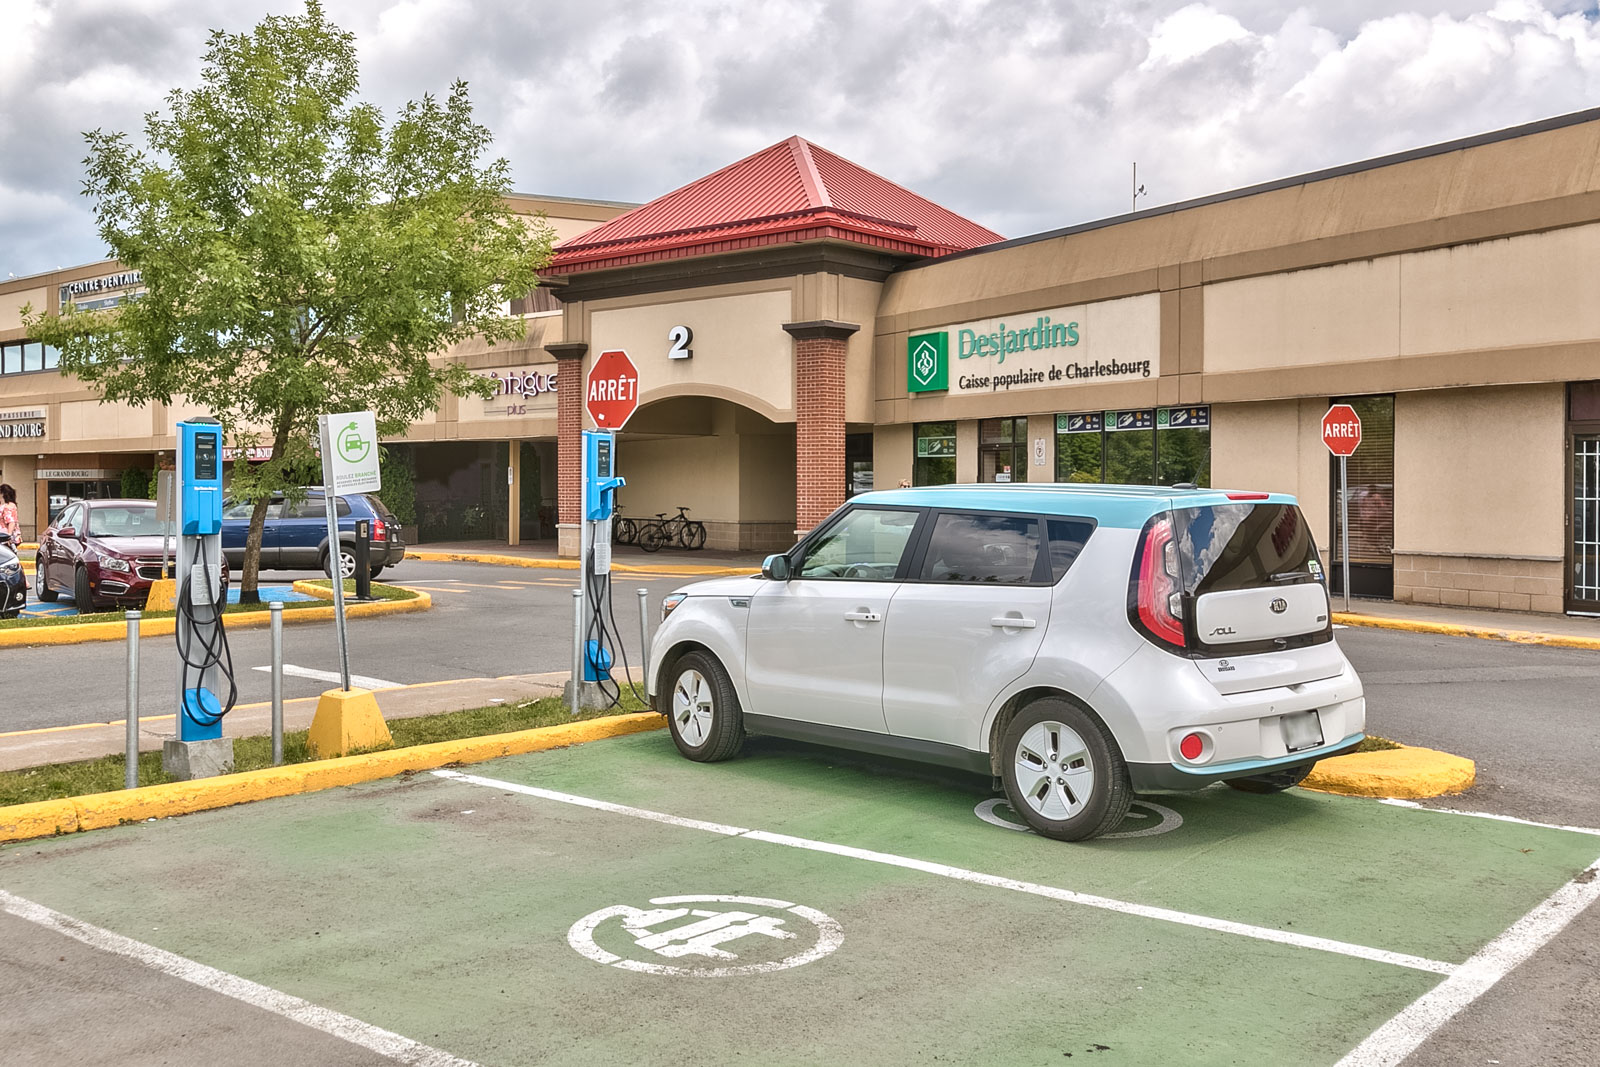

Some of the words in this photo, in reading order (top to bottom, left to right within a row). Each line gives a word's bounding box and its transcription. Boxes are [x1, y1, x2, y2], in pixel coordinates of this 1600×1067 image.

[69, 279, 99, 294] CENTRE
[667, 325, 691, 359] 2
[958, 316, 1080, 365] Desjardins
[959, 374, 990, 390] Caisse
[993, 368, 1045, 391] populaire
[1048, 364, 1063, 381] de
[1065, 358, 1151, 379] Charlesbourg
[588, 374, 637, 402] ARRÊT
[506, 403, 527, 416] plus
[13, 422, 42, 437] BOURG
[1324, 420, 1359, 438] ARRÊT
